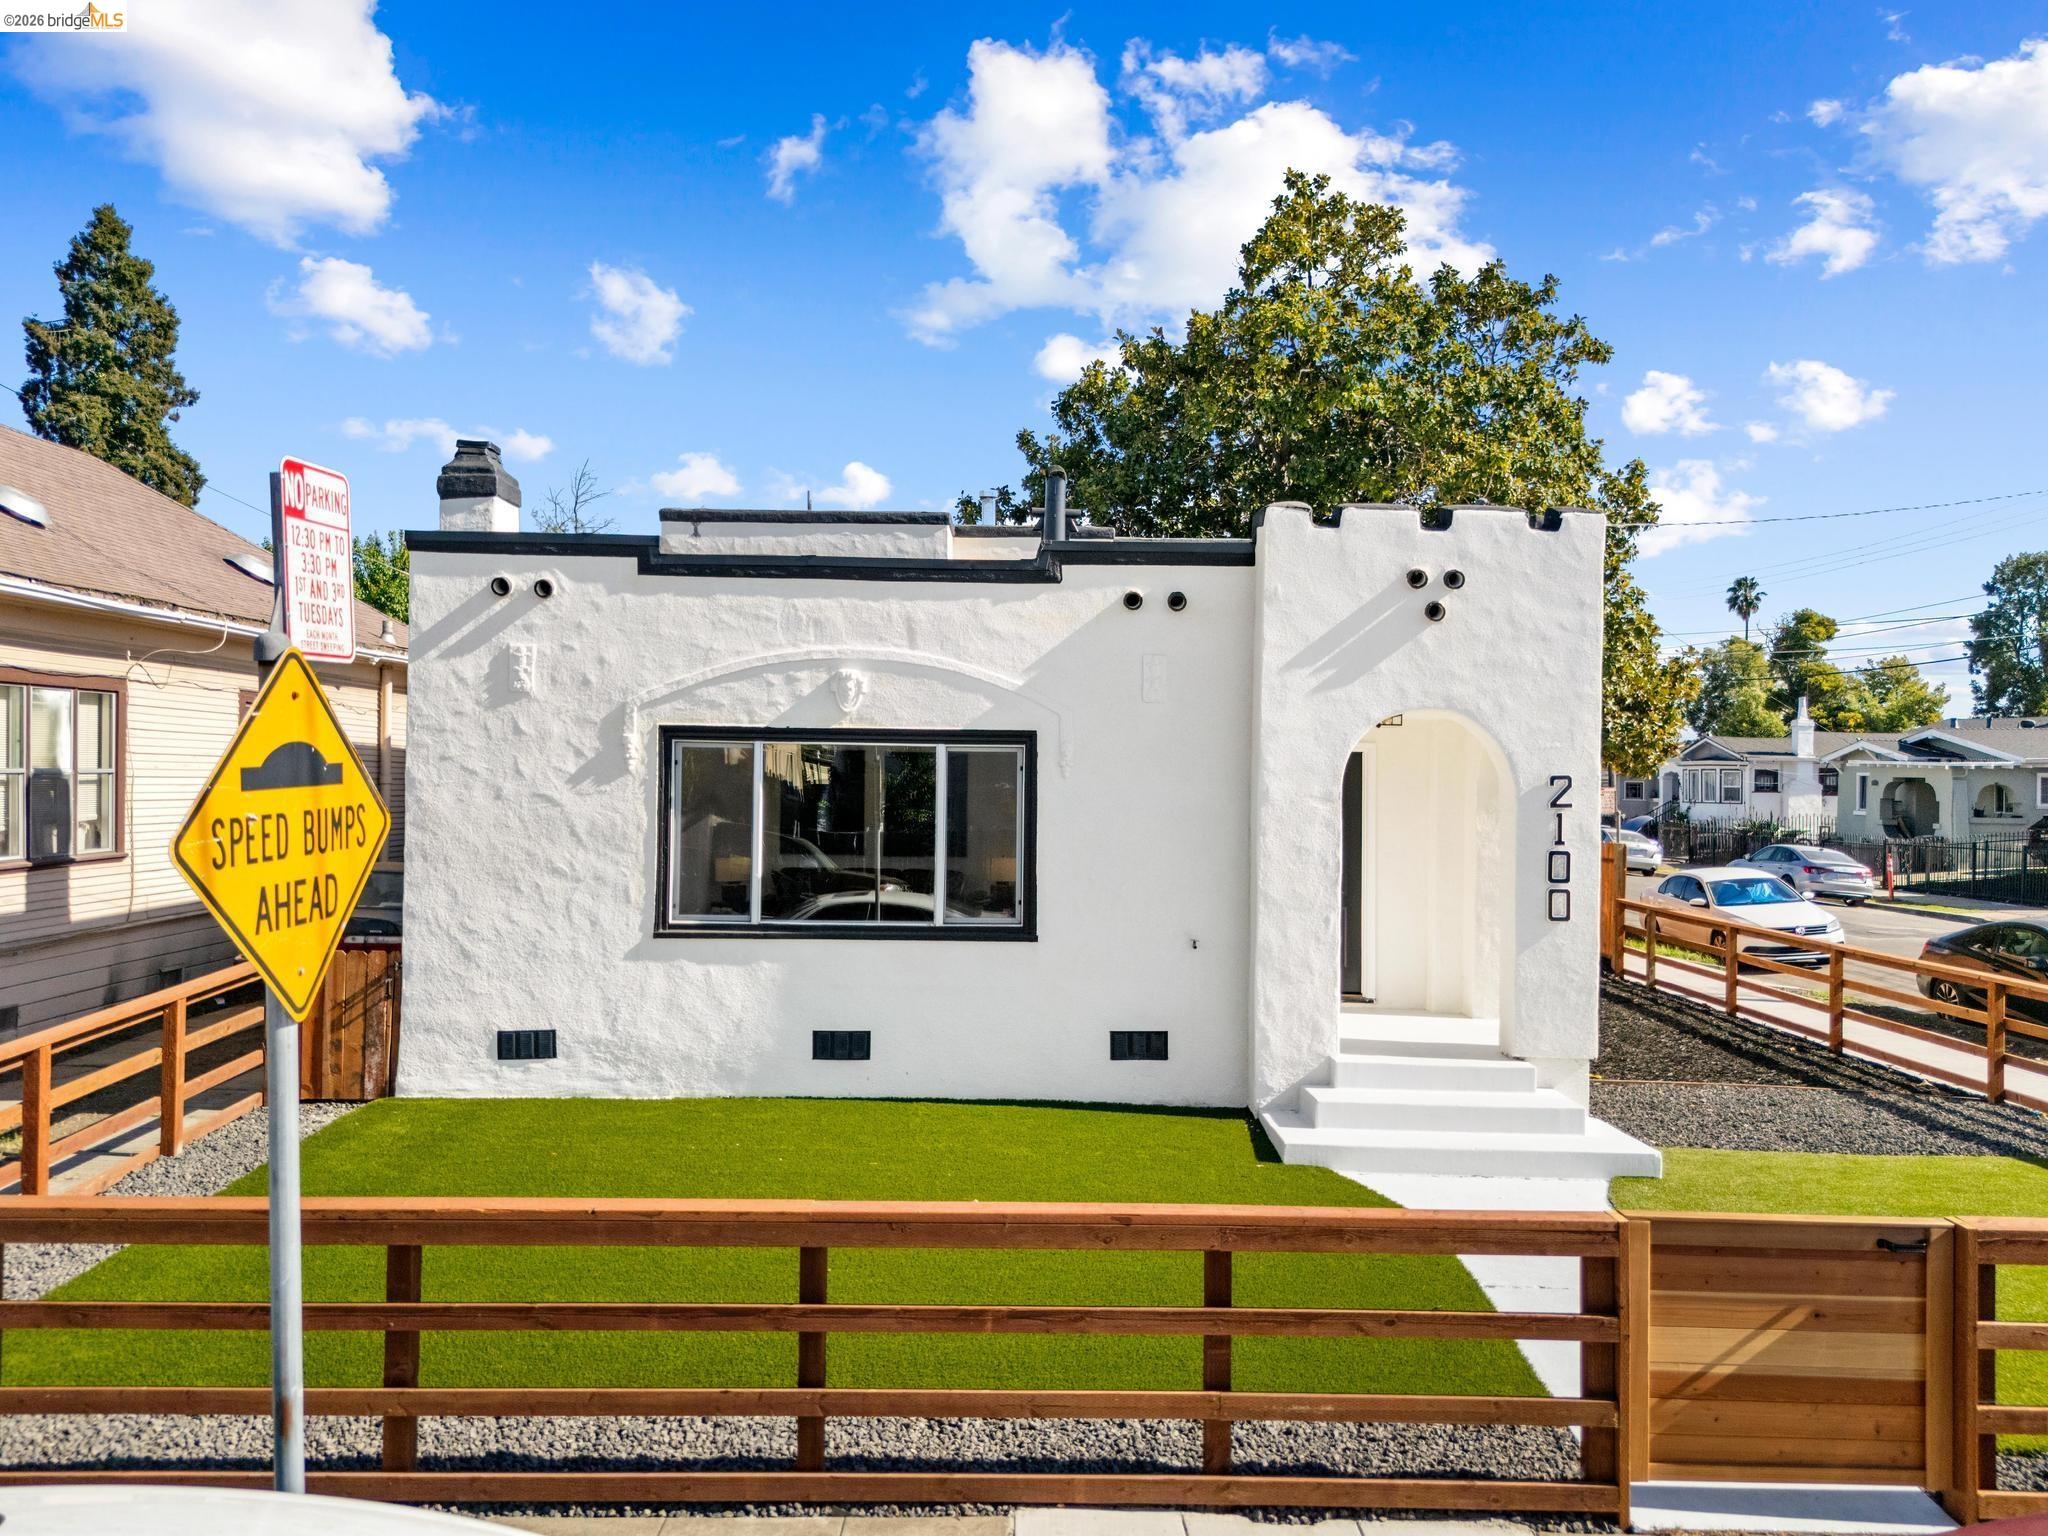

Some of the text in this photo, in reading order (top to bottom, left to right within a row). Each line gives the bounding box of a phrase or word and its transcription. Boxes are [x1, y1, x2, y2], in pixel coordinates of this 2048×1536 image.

[284, 469, 347, 516] NO PARKING
[291, 524, 345, 556] 12:30 PM TO
[301, 552, 338, 579] 3:30 PM
[295, 576, 345, 603] 1ST AND 3RD
[298, 601, 344, 627] TUESDAYS
[301, 640, 345, 652] STREET SWEEPING
[306, 629, 320, 639] EACH
[211, 803, 366, 871] SPEED BUMPS
[1548, 775, 1573, 922] 2100
[254, 873, 338, 936] AHEAD
